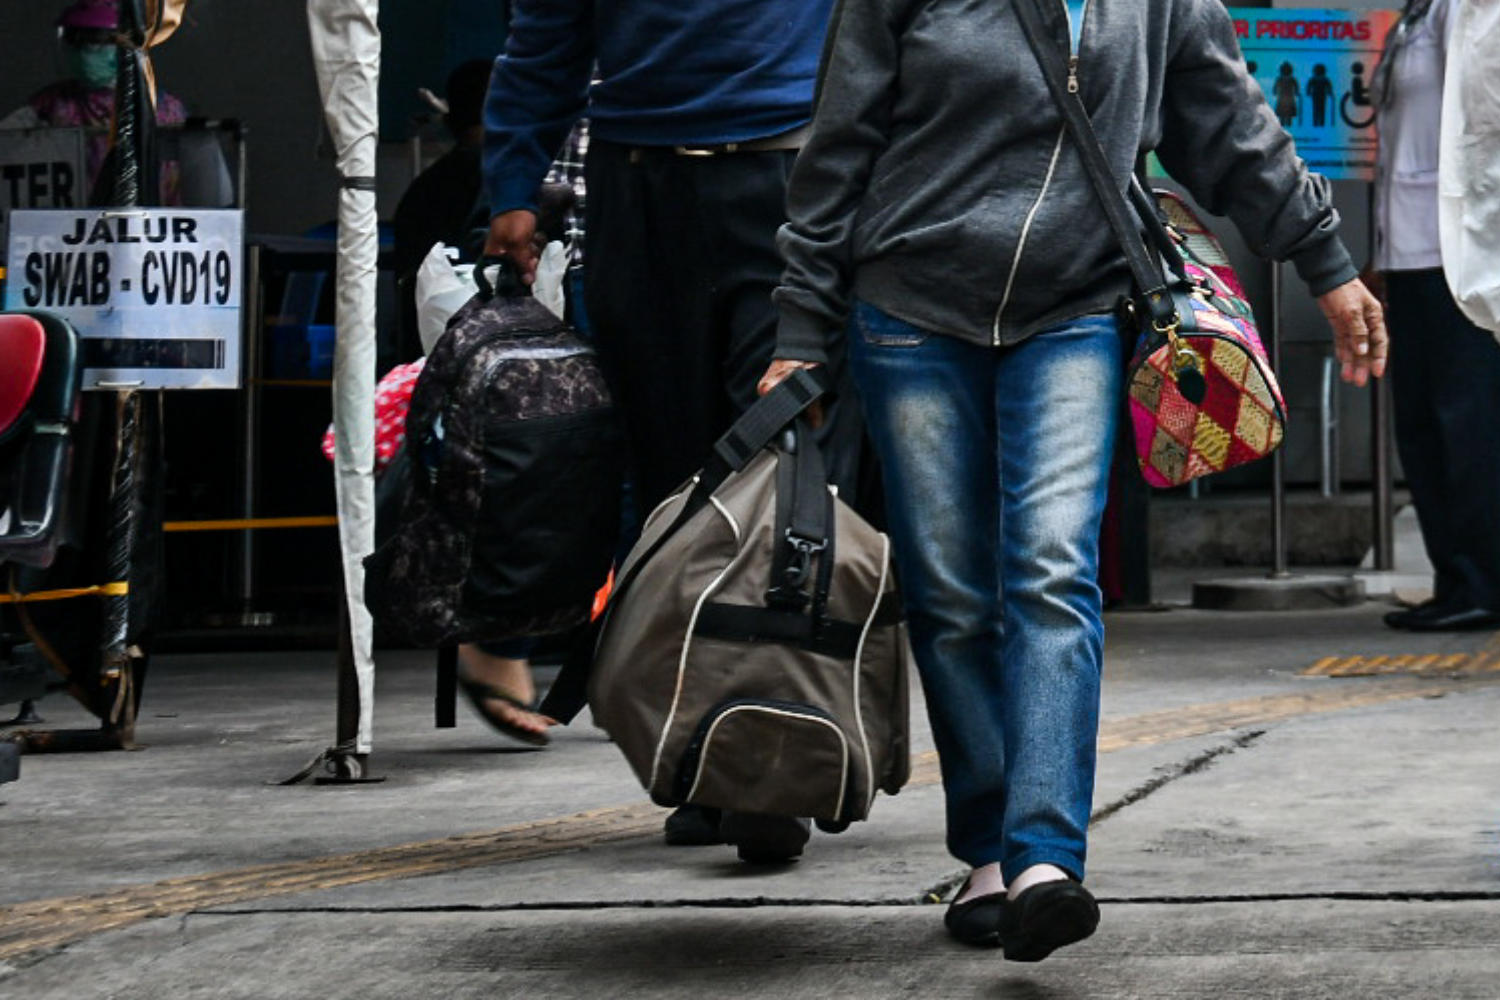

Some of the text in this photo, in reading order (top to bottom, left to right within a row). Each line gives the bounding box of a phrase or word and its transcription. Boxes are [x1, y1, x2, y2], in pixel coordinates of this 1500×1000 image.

[1256, 19, 1372, 41] PRIORITAS
[62, 217, 199, 244] JALUR
[23, 250, 111, 308] SWAB
[141, 250, 232, 306] CVD19
